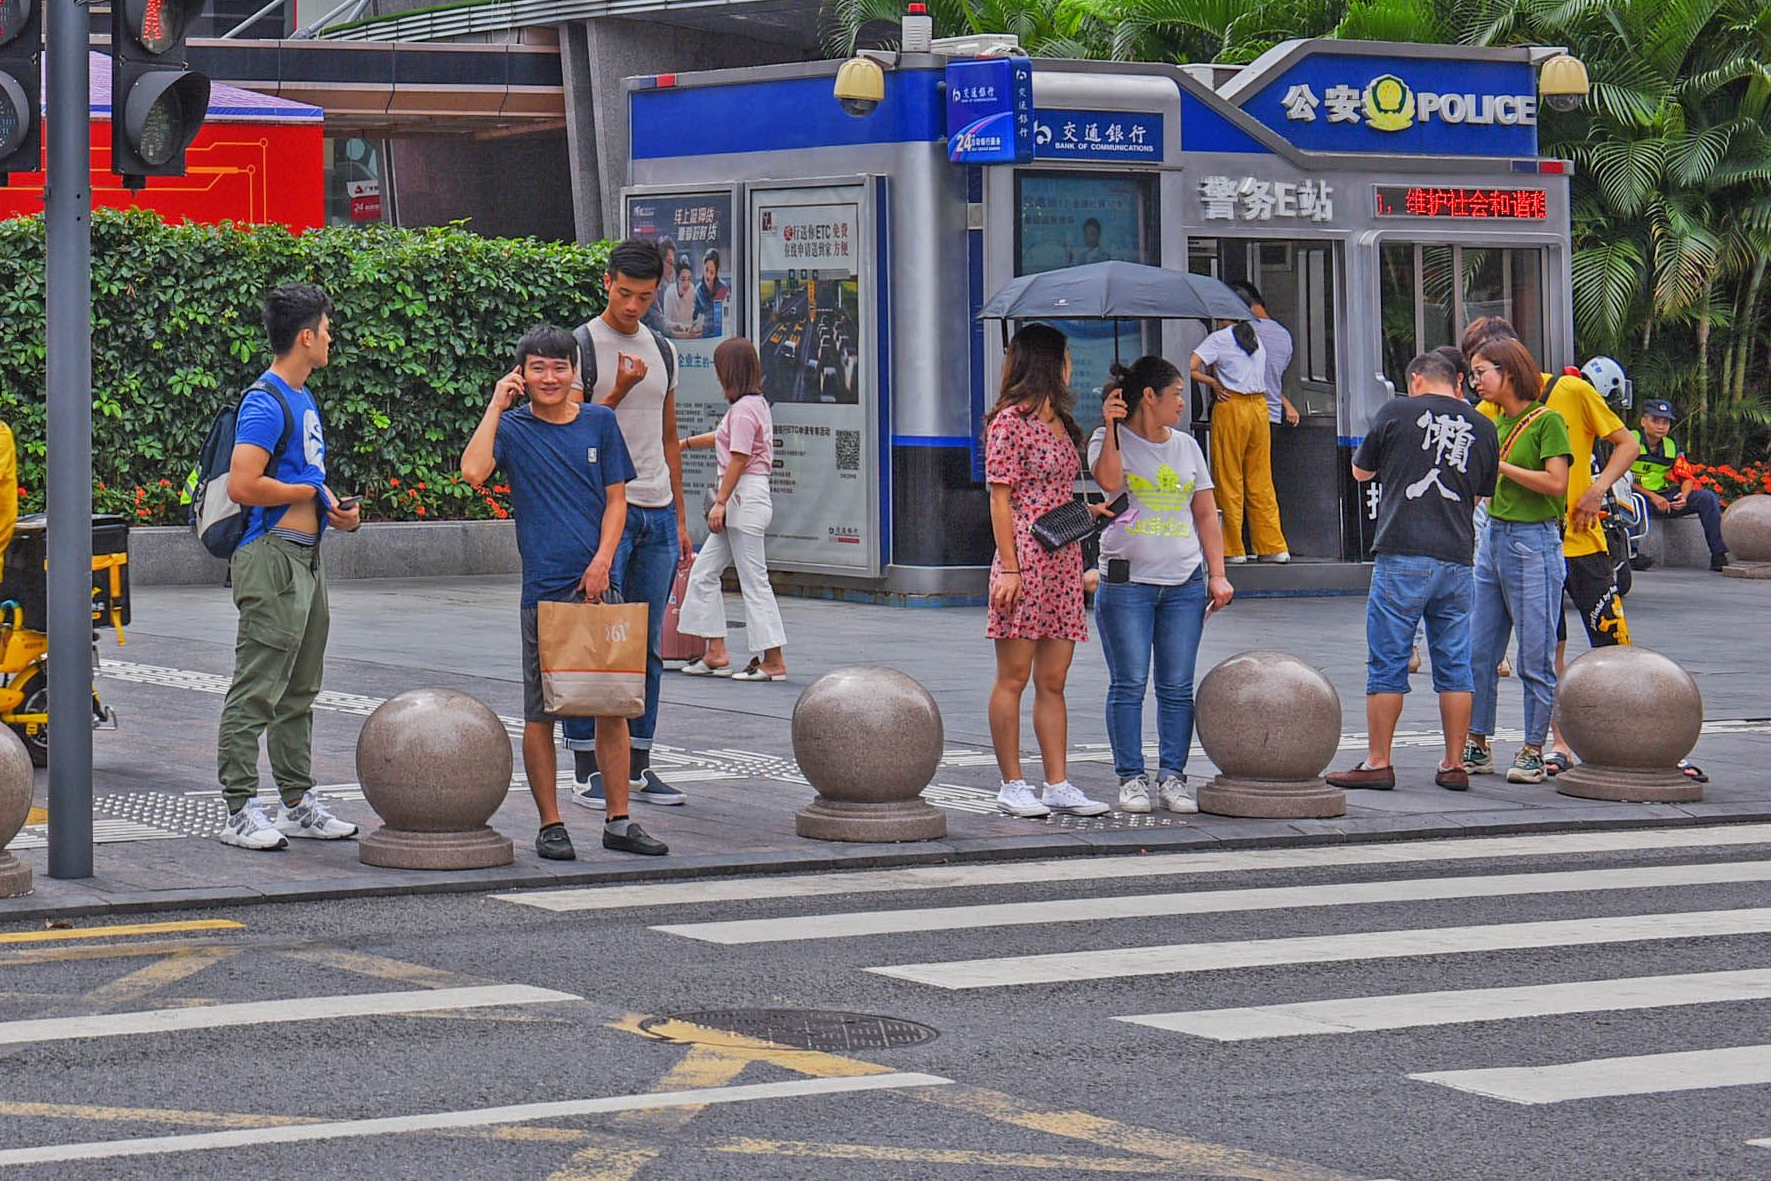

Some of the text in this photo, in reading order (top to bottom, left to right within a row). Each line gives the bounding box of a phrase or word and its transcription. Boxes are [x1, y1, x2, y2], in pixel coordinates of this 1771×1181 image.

[1282, 84, 1537, 126] 公安 POLICE
[1055, 142, 1154, 152] BANK OF COMMUNICATIONS
[1062, 121, 1146, 144] 交通銀行
[1198, 176, 1333, 222] 警务E站
